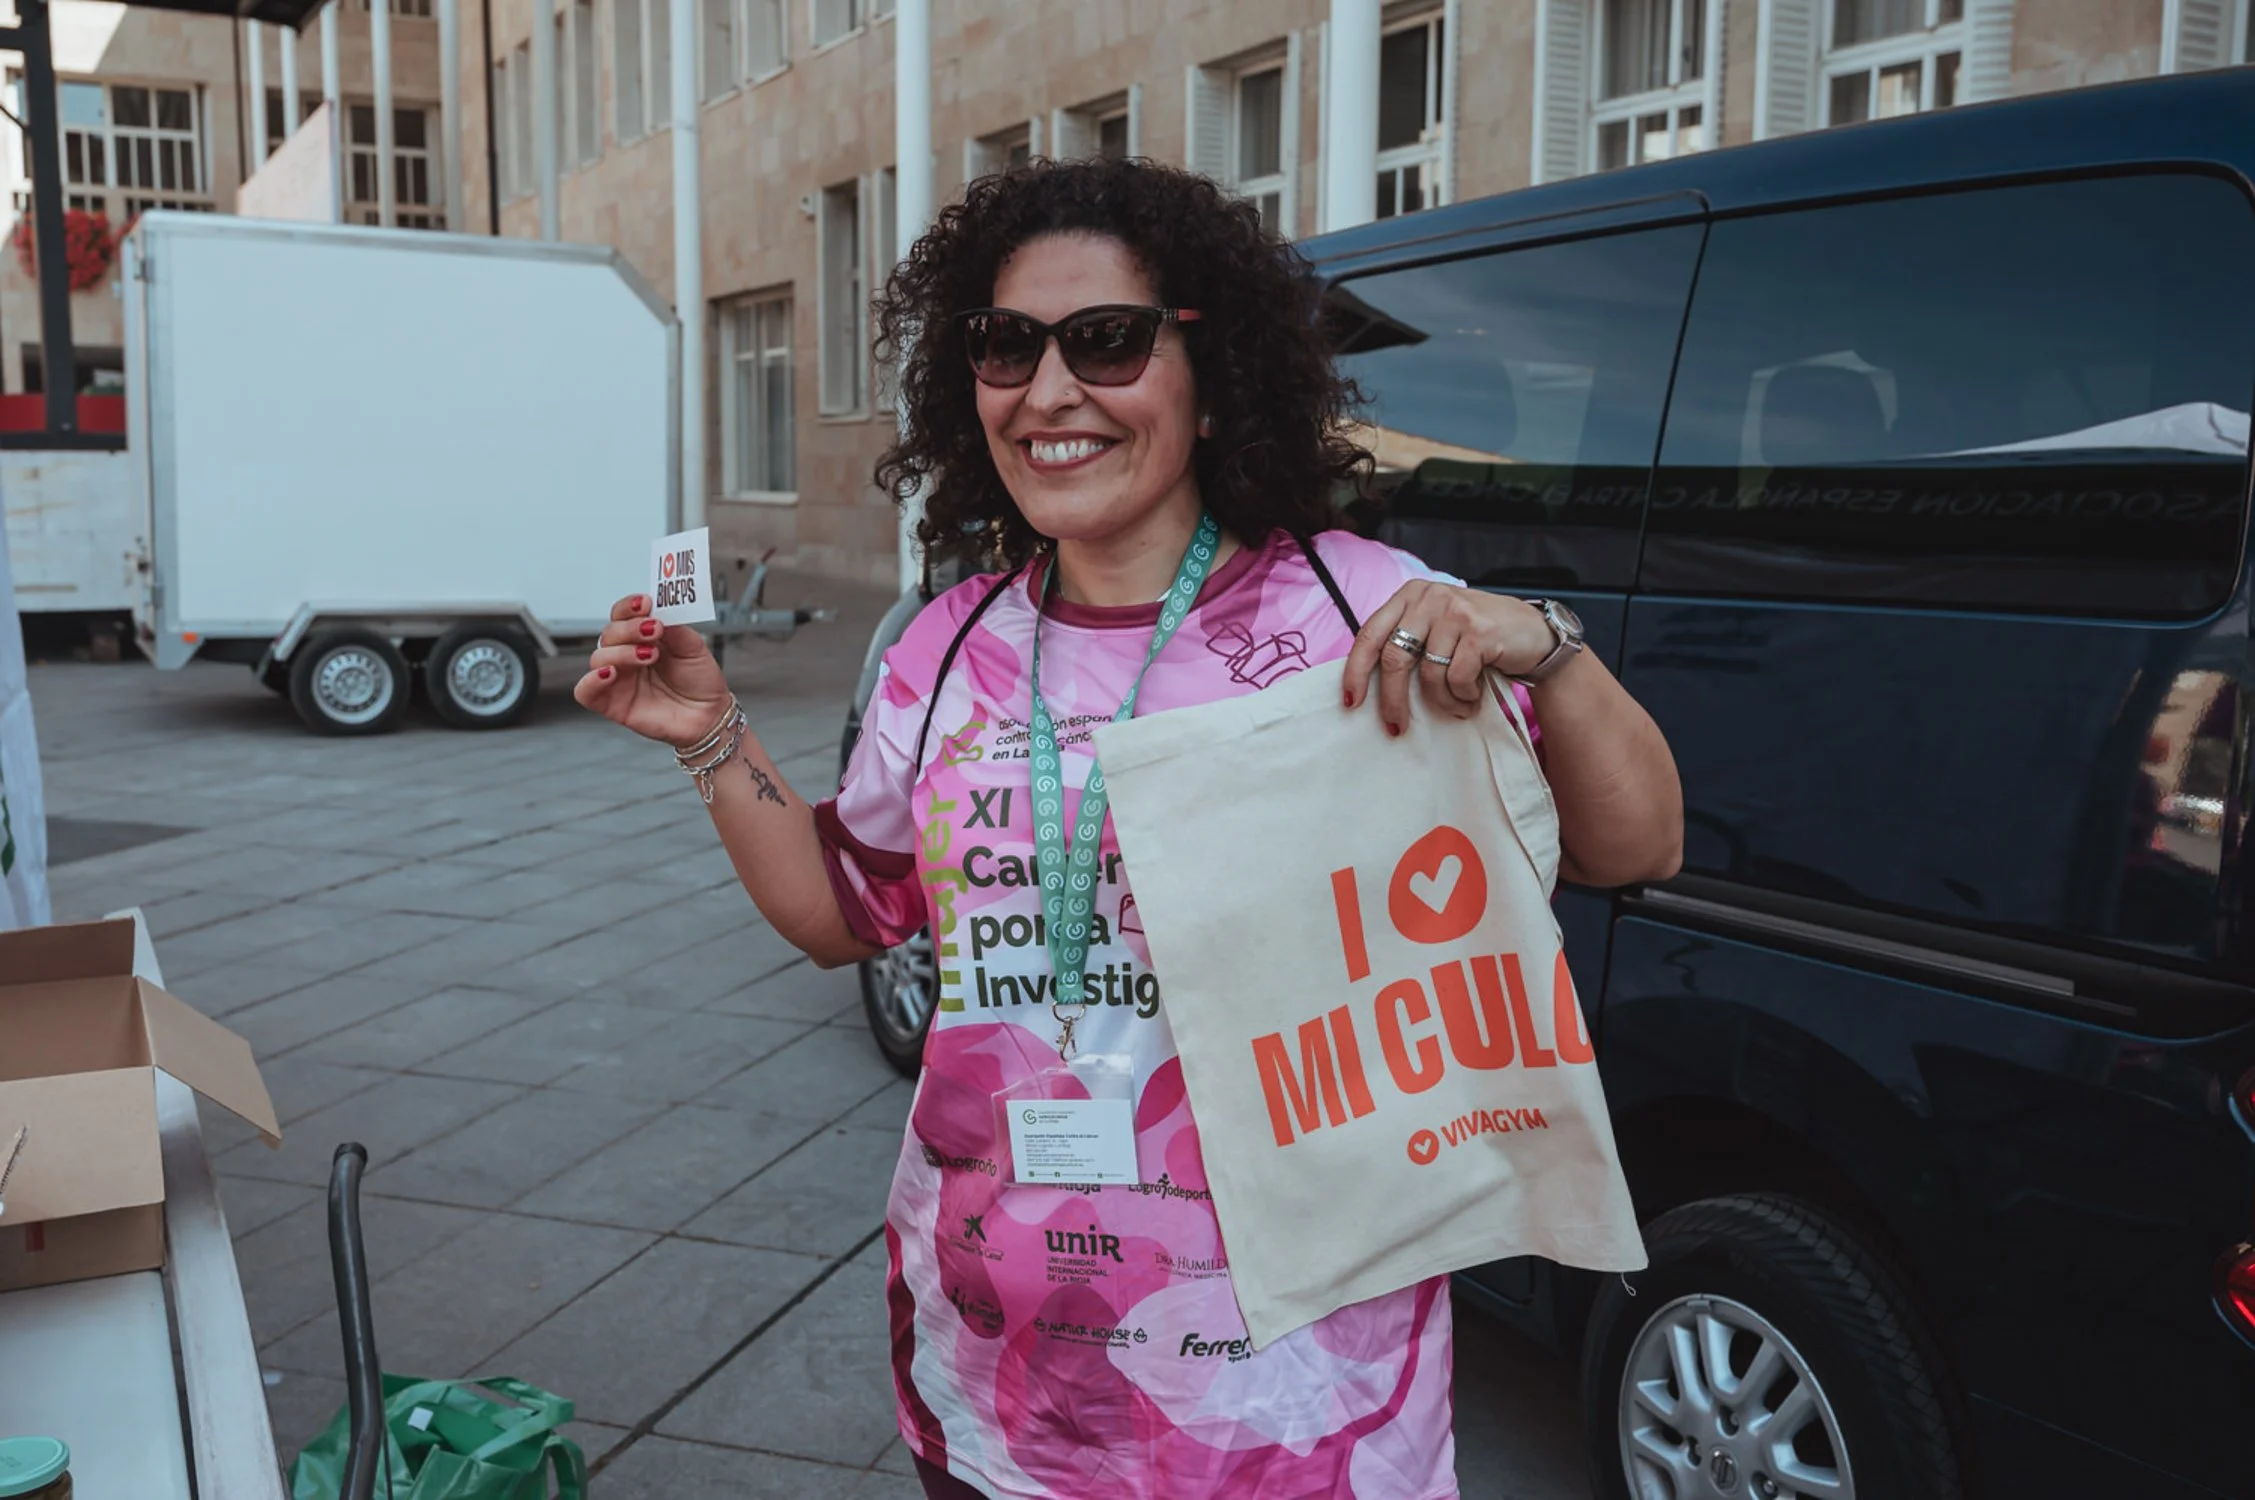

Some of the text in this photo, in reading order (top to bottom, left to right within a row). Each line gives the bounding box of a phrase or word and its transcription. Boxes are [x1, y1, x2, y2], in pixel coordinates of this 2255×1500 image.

[657, 549, 695, 581] I MIS
[992, 748, 1030, 760] en La
[963, 788, 1013, 828] XI
[1330, 866, 1370, 983] I
[1251, 1004, 1376, 1147] MI
[1440, 1108, 1549, 1148] VIVAGYM
[1047, 1265, 1108, 1277] INTERNACIONAL
